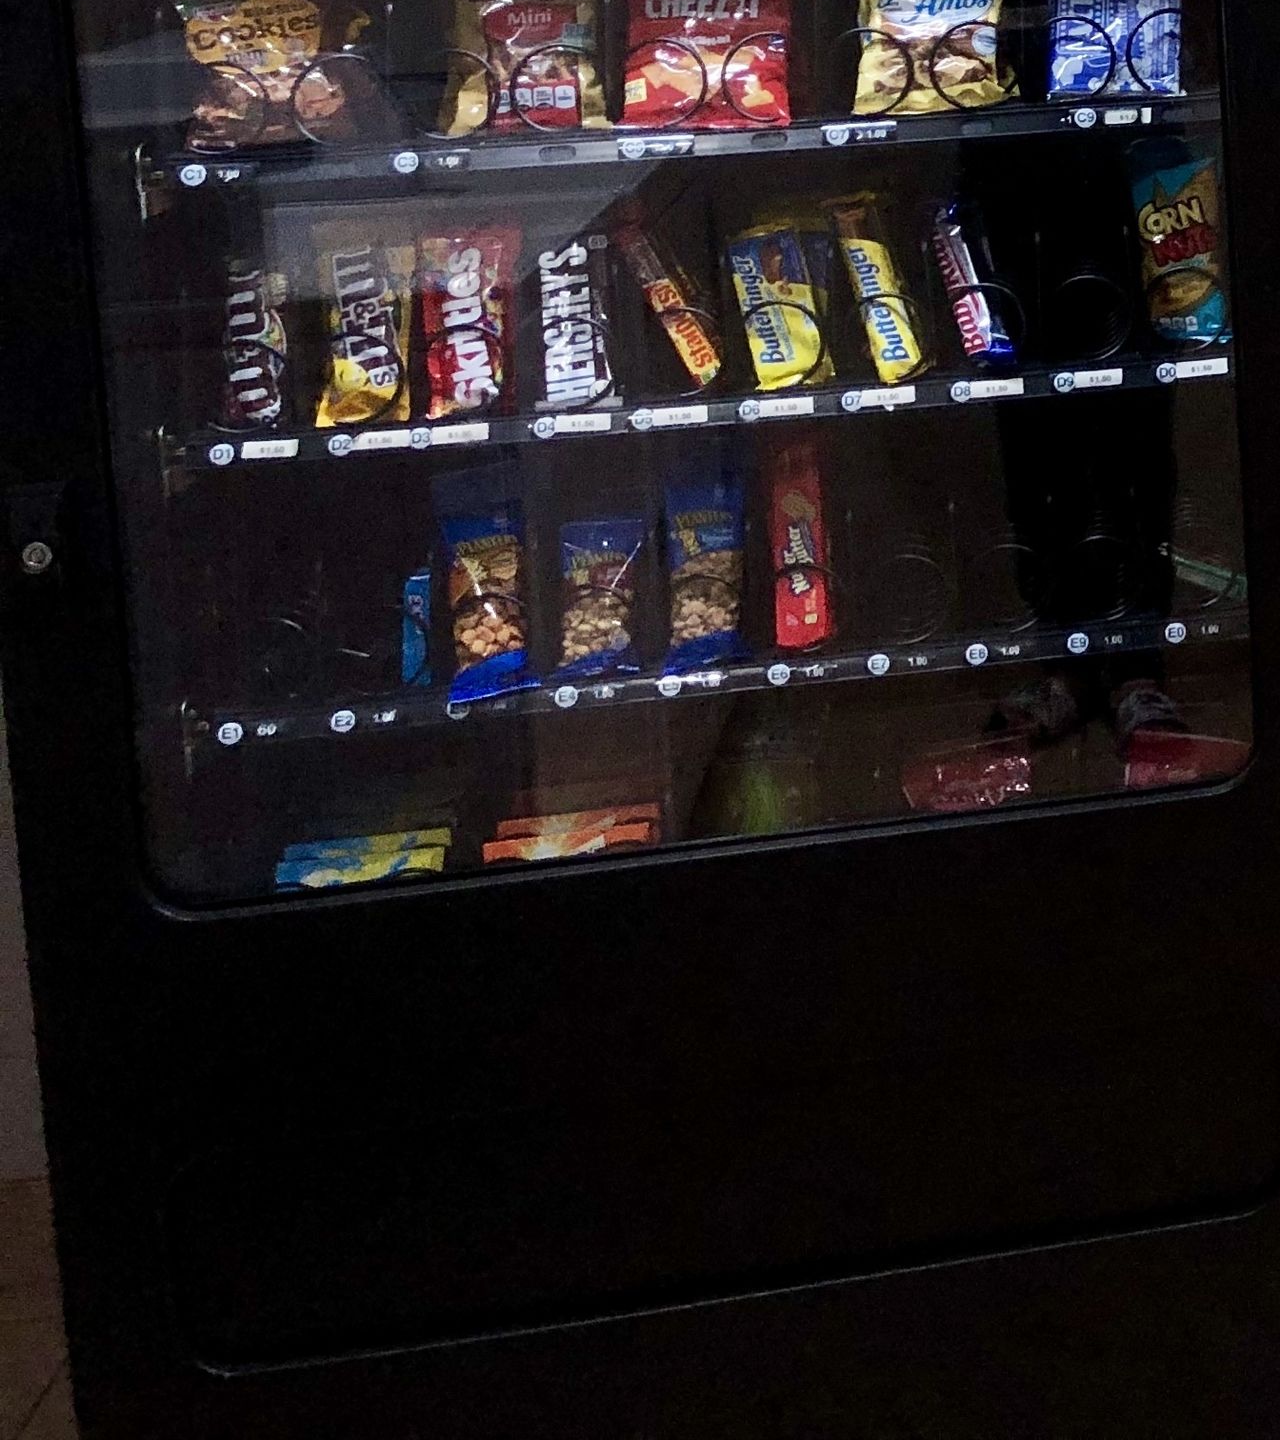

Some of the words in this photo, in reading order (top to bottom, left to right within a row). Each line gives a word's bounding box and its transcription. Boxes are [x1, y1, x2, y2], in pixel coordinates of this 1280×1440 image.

[506, 8, 552, 26] Mini
[1076, 111, 1095, 124] C9
[827, 129, 848, 141] C7
[396, 156, 417, 169] C3
[183, 168, 203, 181] C1
[1137, 198, 1205, 242] CORN
[441, 247, 500, 408] Skittles
[538, 242, 596, 403] HERSHEY'S
[1159, 366, 1176, 379] D0
[1056, 375, 1074, 388] D9
[953, 386, 971, 398] D8
[844, 394, 860, 408] D7
[741, 404, 760, 417] D6
[536, 420, 555, 434] D4
[331, 437, 352, 452] D2
[411, 432, 431, 446] D3
[213, 447, 232, 461] D1
[783, 549, 811, 595] Nuer
[1167, 626, 1185, 639] E0
[1069, 636, 1087, 648] E9
[870, 657, 888, 670] E7
[771, 669, 790, 681] E6
[334, 714, 354, 727] E2
[221, 726, 240, 740] E1
